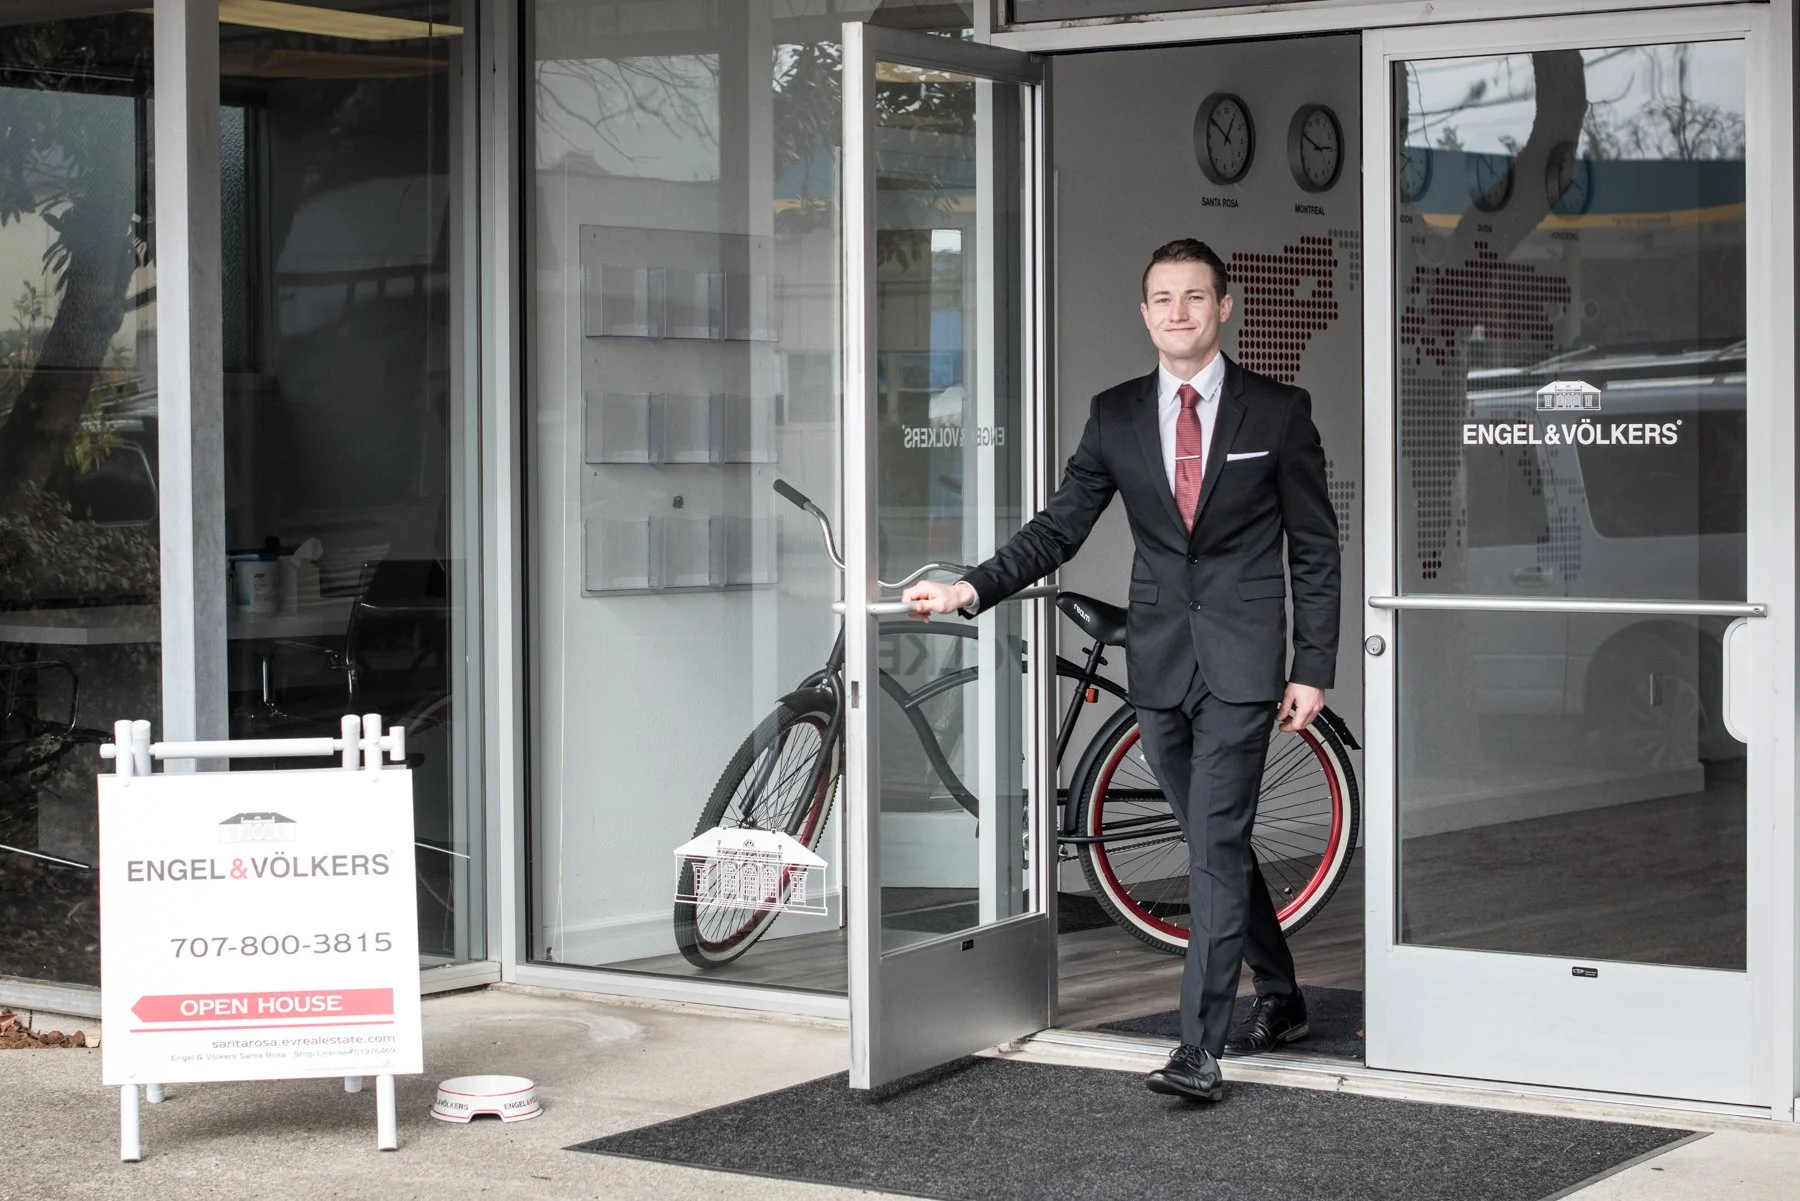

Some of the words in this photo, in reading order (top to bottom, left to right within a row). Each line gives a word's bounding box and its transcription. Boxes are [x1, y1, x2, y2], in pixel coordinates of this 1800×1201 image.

[1201, 197, 1221, 207] SANTA
[1222, 198, 1239, 208] ROSA
[1294, 204, 1325, 216] MONTREAL
[170, 932, 393, 958] 707-800-3815
[179, 998, 248, 1017] OPEN
[257, 995, 343, 1014] HOUSE
[212, 1033, 396, 1049] santarosa.evrealestate.com
